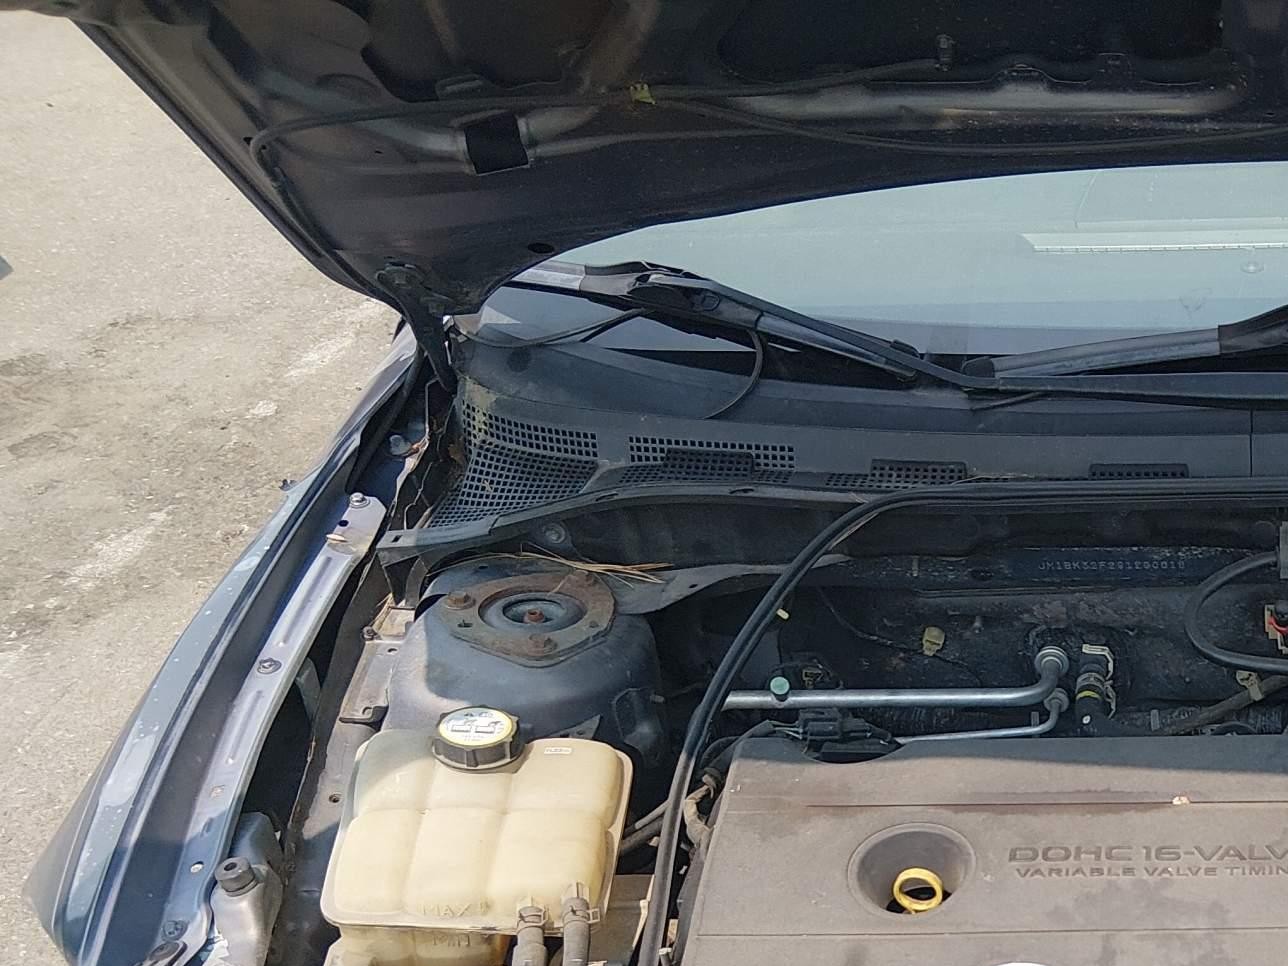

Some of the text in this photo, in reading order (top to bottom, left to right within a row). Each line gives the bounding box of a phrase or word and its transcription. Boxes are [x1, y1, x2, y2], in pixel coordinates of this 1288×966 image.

[1008, 845, 1134, 863] DOHC
[1016, 866, 1137, 879] VARIABLE
[1144, 865, 1218, 878] VALVE
